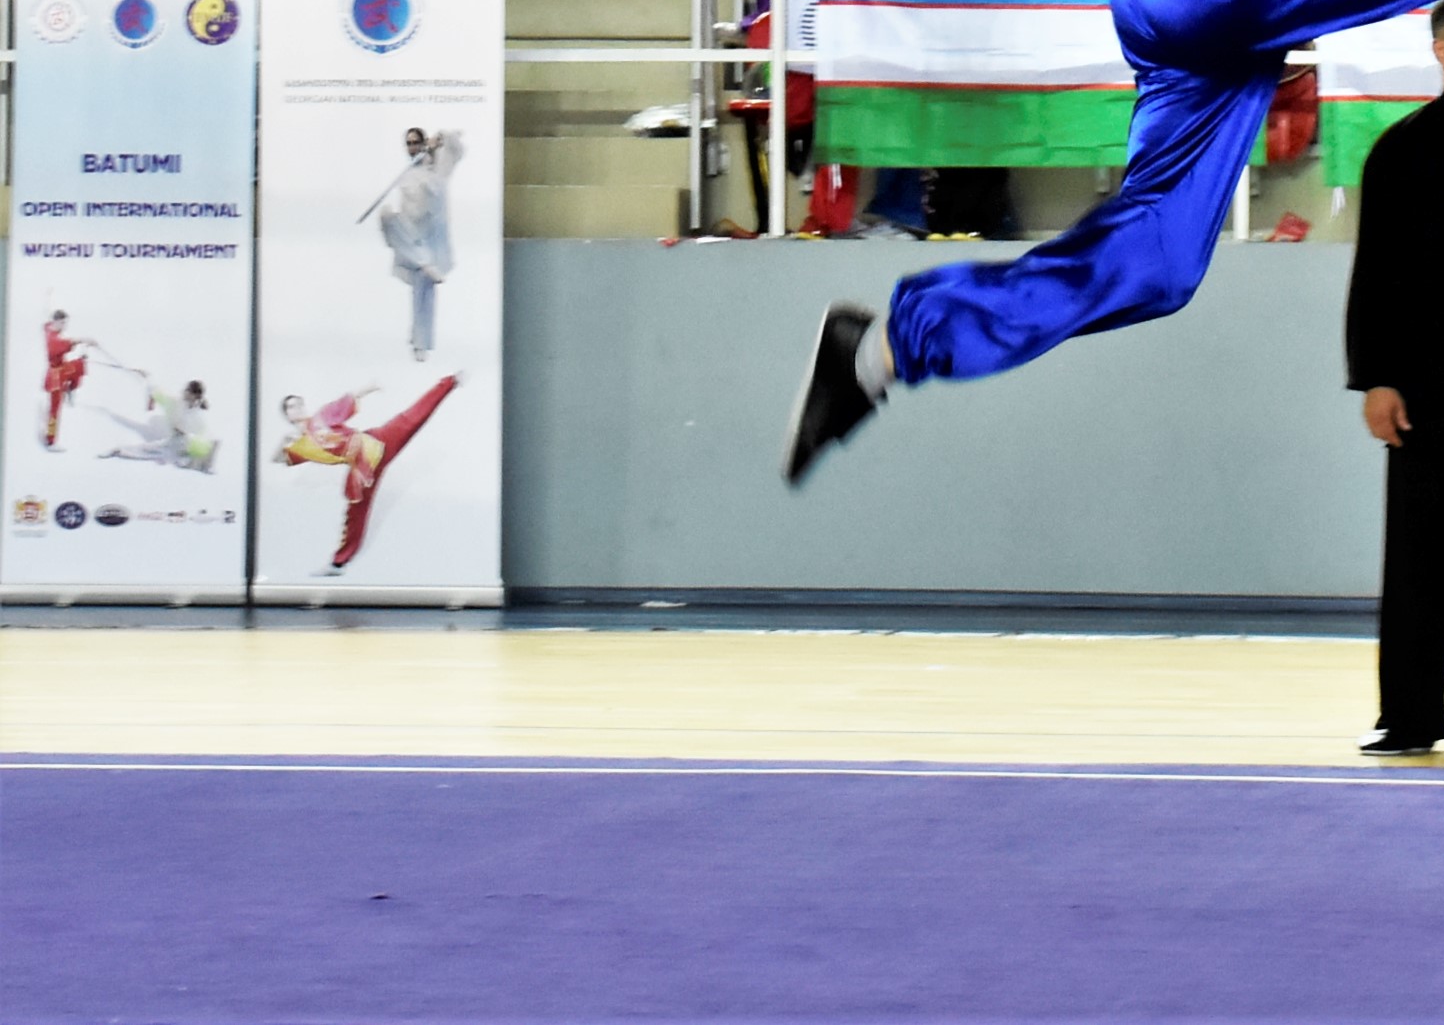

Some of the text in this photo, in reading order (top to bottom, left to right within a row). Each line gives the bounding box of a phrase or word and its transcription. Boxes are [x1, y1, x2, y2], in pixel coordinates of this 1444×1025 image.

[82, 153, 181, 174] BATUMI
[23, 201, 241, 218] OPEN INTERNATIONAL
[23, 243, 237, 259] WUSHU TOURNAMENT
